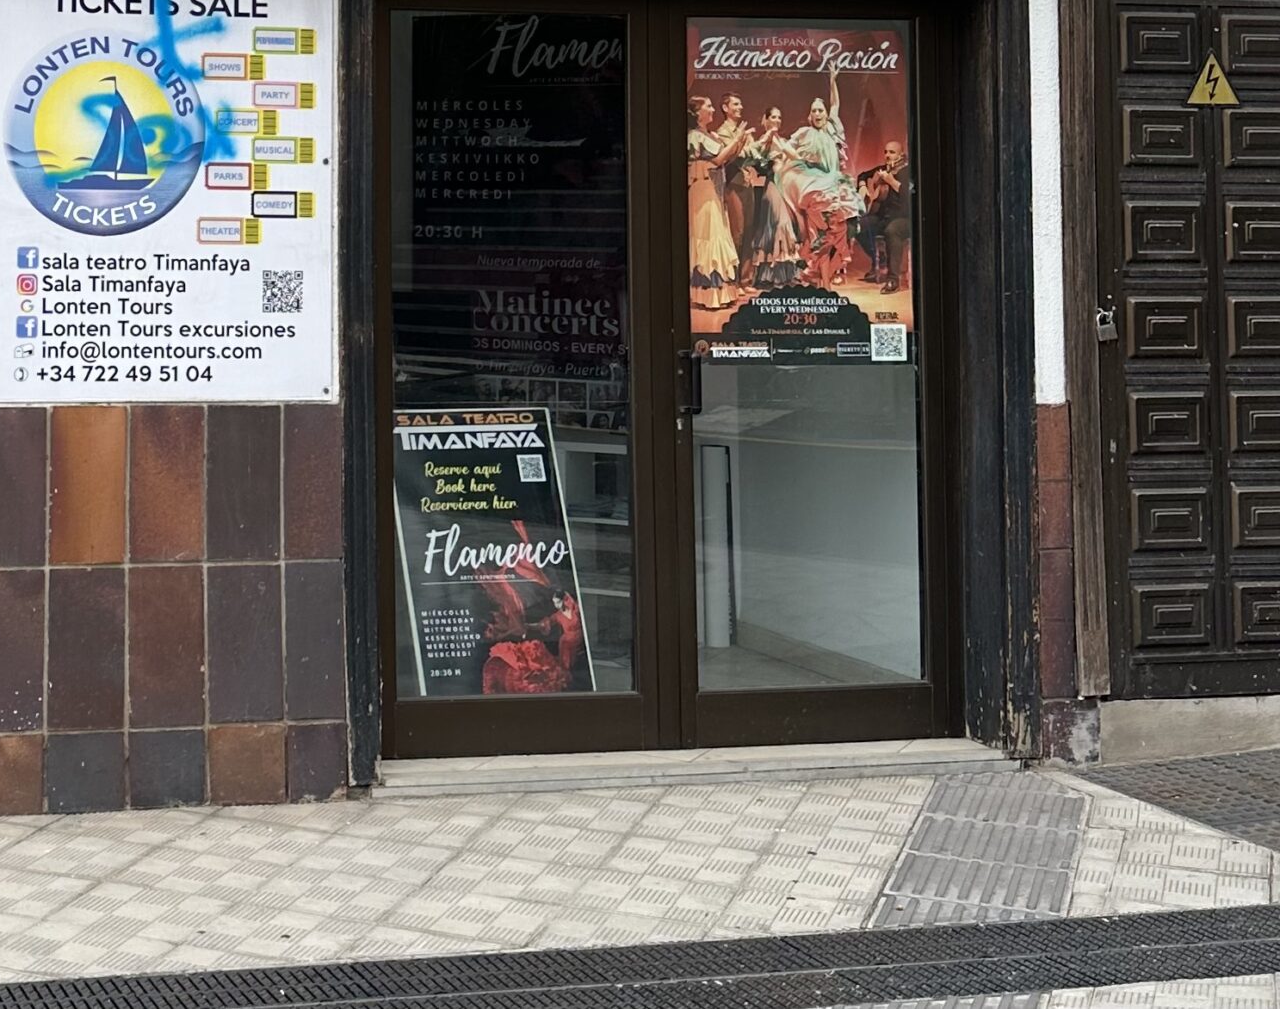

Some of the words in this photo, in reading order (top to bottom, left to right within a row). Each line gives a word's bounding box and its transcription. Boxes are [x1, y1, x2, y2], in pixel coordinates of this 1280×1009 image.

[730, 37, 769, 46] BALLET
[771, 36, 817, 47] ESPAÑOL
[694, 36, 811, 69] Flamenco
[817, 38, 898, 73] Pasión
[208, 63, 241, 71] SHOWS
[14, 36, 110, 114] LONTEN
[121, 38, 194, 117] TOURS
[261, 91, 289, 99] PARTY
[416, 98, 523, 111] MIÉRCOLES
[218, 118, 258, 126] CONCERT
[415, 117, 531, 129] WEDNESDAY
[415, 135, 519, 146] MITTWOCH
[255, 146, 294, 154] MUSICAL
[415, 153, 540, 164] KESKIVIIKKO
[214, 172, 243, 181] PARKS
[415, 168, 525, 182] MERCOLEDÌ
[415, 188, 512, 200] MERCREDI
[51, 193, 157, 226] TICKETS
[256, 201, 293, 209] COMEDY
[200, 227, 240, 235] THEATER
[414, 225, 463, 238] 20:30
[471, 226, 483, 239] H
[42, 253, 79, 270] sala
[86, 254, 146, 271] teatro
[154, 254, 250, 275] Timanfaya
[477, 254, 514, 266] Nueva
[517, 256, 584, 271] temporada
[585, 257, 601, 268] de
[42, 275, 81, 292] Sala
[89, 275, 186, 297] Timanfaya
[42, 298, 111, 315] Lonten
[118, 298, 173, 315] Tours
[478, 289, 610, 317] Matinee
[800, 296, 848, 306] MIÉRCOLES
[473, 307, 620, 337] Concerts
[784, 313, 817, 325] 20:30
[41, 320, 111, 337] Lonten
[118, 320, 173, 337] Tours
[179, 321, 296, 338] excursiones
[42, 341, 262, 363] info@lontentours.com
[492, 338, 560, 352] DOMINGOS
[570, 342, 614, 355] EVERY
[710, 346, 771, 358] TIMANFAYA
[36, 366, 76, 382] +34
[82, 366, 119, 382] 722
[125, 366, 152, 382] 49
[159, 366, 179, 382] 51
[186, 366, 213, 382] 04
[396, 414, 454, 426] SALA
[462, 412, 534, 424] TEATRO
[393, 424, 545, 451] TIMANFAYA
[424, 461, 469, 477] Reserve
[473, 462, 502, 478] aquí
[435, 478, 466, 494] Book
[470, 478, 496, 492] here
[420, 497, 489, 513] Reservieren
[492, 495, 517, 509] hier
[424, 523, 569, 577] Flamenco
[422, 617, 474, 625] WEDNESDAY
[430, 669, 453, 677] 20:30
